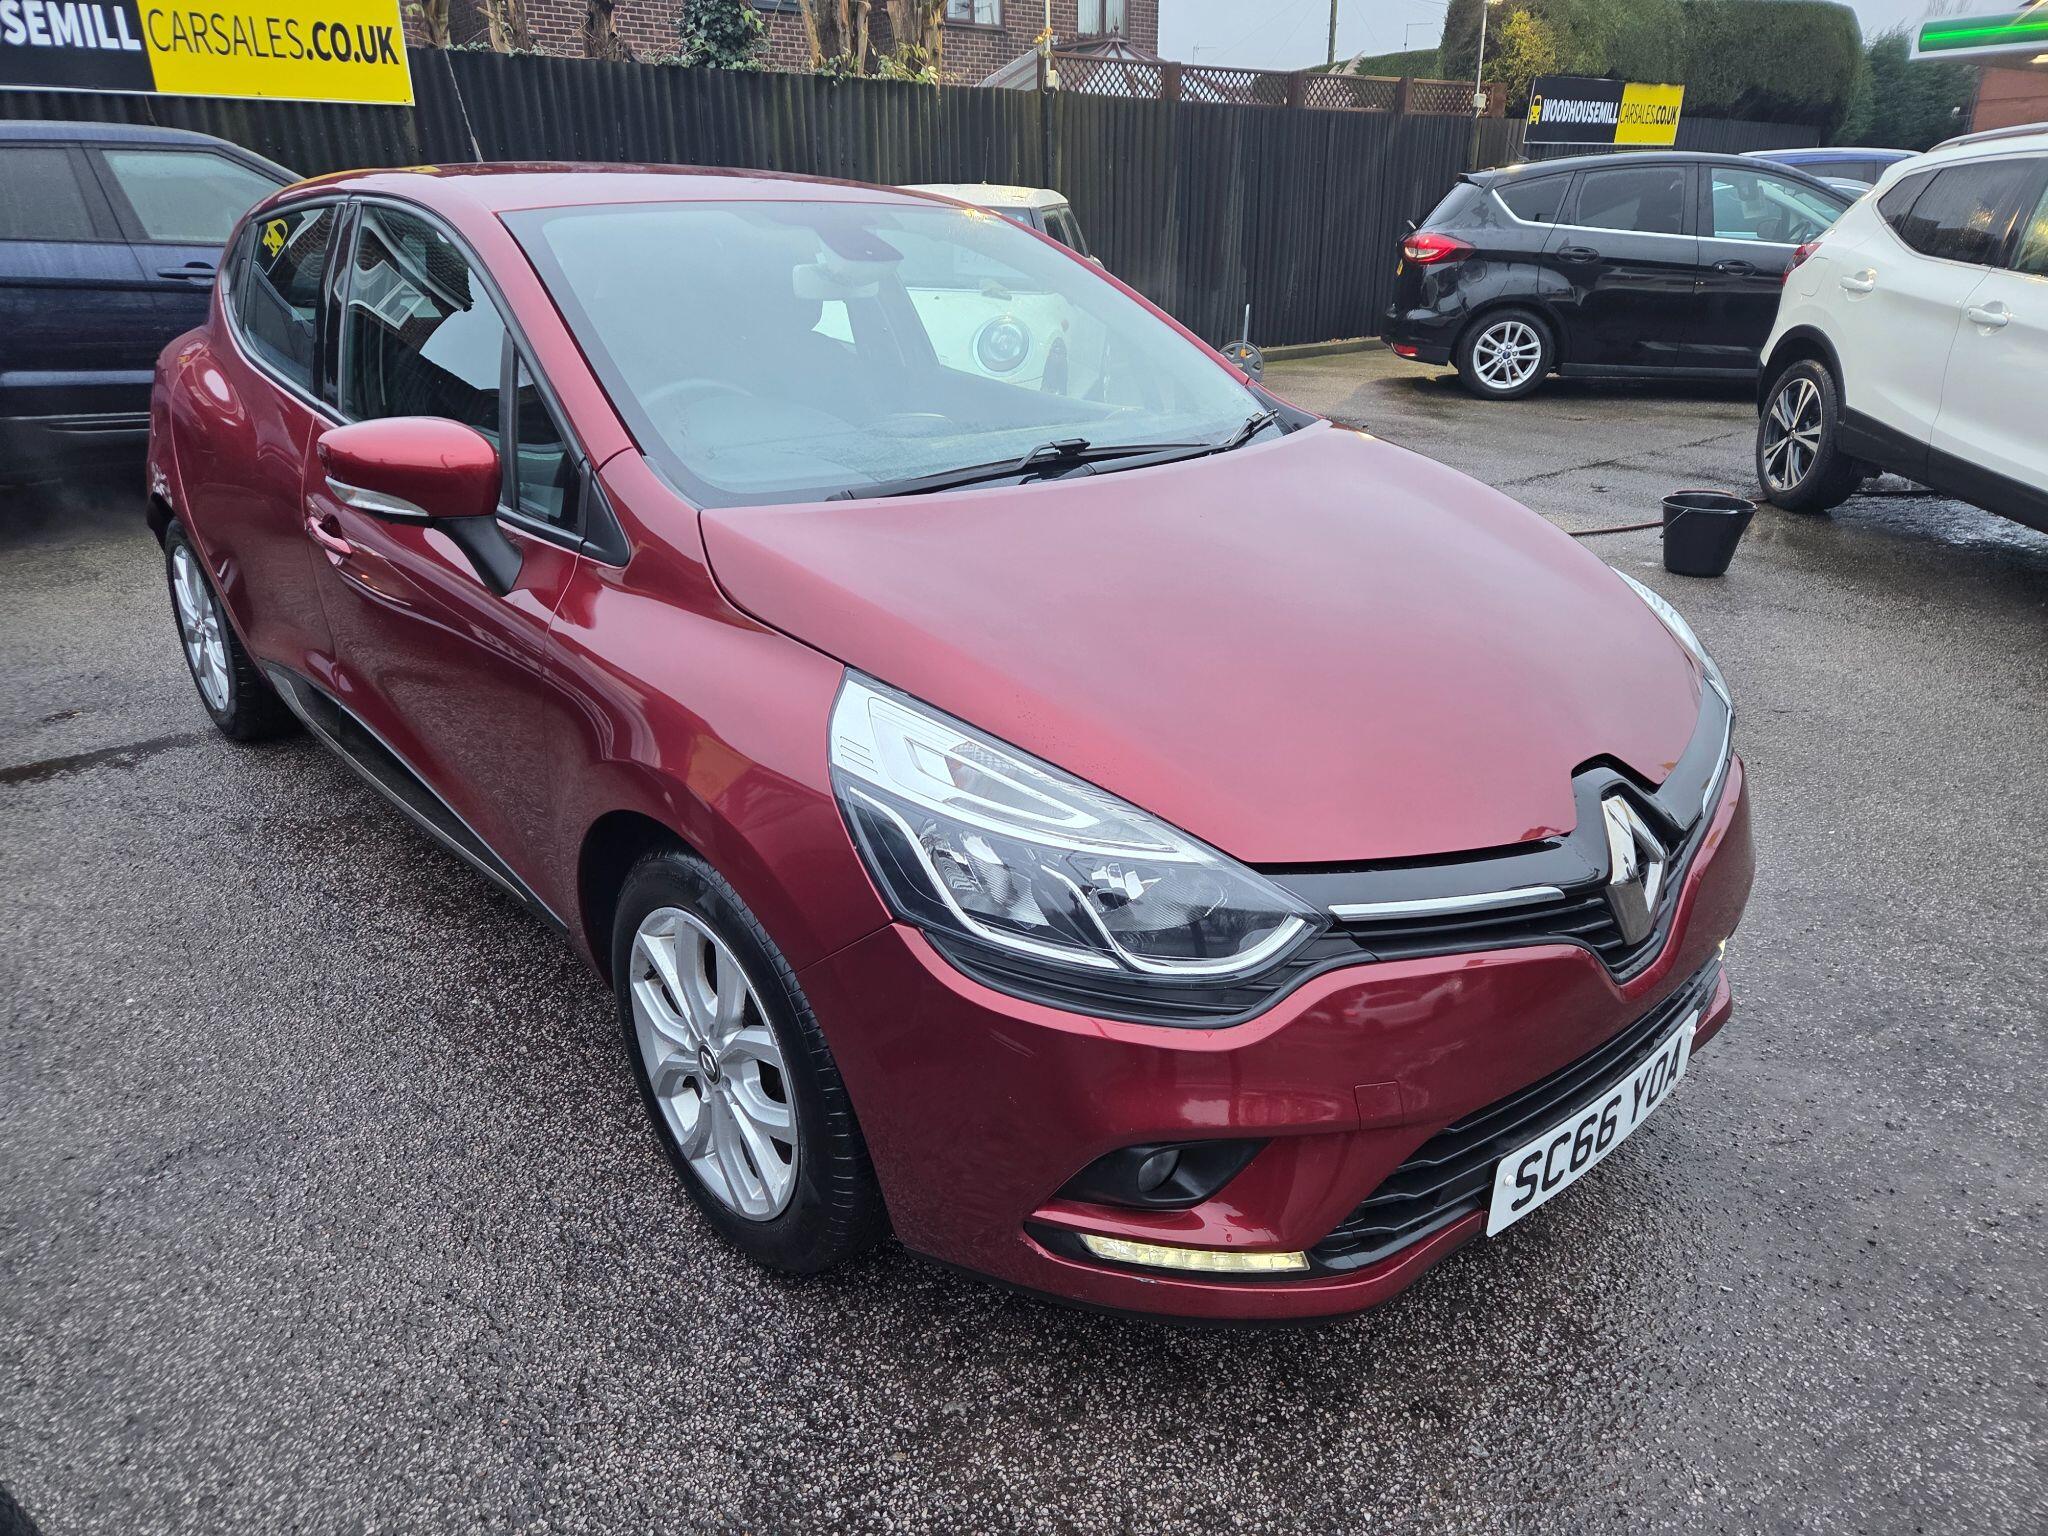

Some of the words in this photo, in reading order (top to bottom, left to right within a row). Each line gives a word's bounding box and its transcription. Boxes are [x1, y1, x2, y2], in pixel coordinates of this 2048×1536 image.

[147, 9, 400, 65] CARSALES.CO.UK
[1541, 99, 1618, 124] WOODHOUSEMILL
[1620, 103, 1678, 126] CARSALES.CO.UK
[1511, 1094, 1622, 1212] SC66
[1630, 1035, 1682, 1125] YOA
